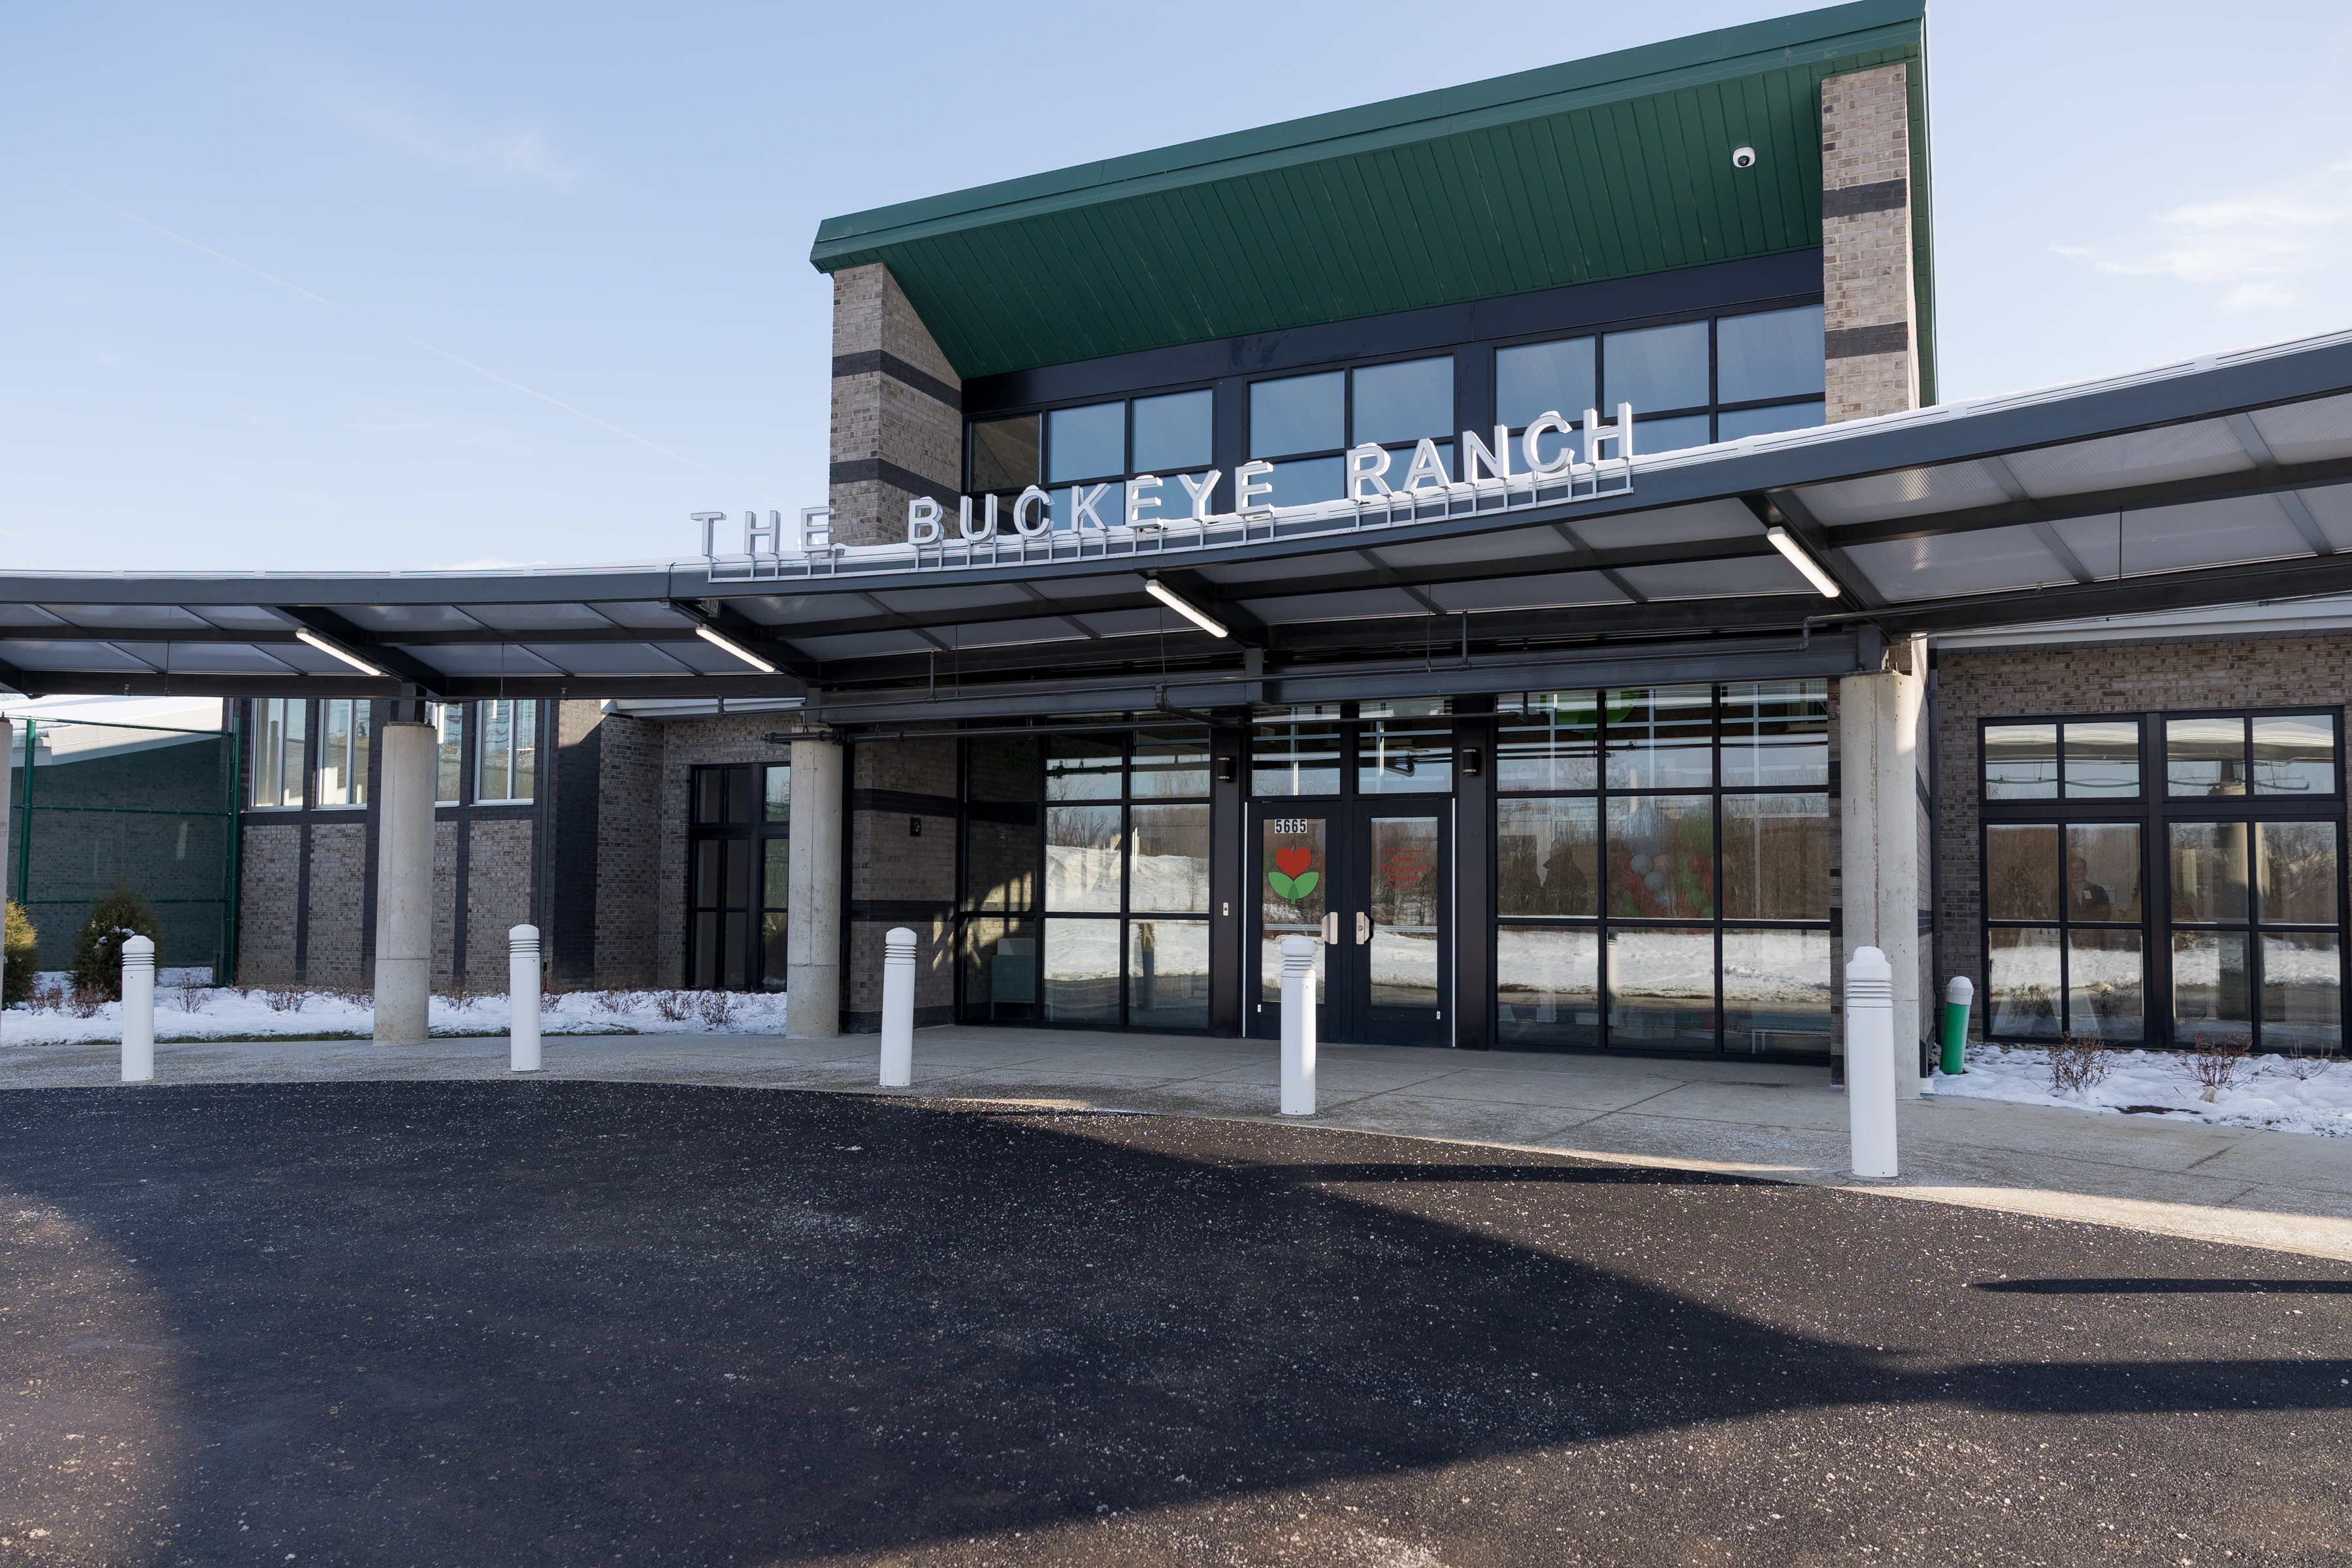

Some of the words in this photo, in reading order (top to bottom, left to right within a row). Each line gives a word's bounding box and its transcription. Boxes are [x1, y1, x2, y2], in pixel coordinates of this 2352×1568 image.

[690, 505, 835, 557] THE
[907, 461, 1275, 546] BUCKEYE
[1346, 401, 1633, 502] RANCH
[1275, 819, 1306, 833] 5665
[1392, 855, 1416, 864] Hope
